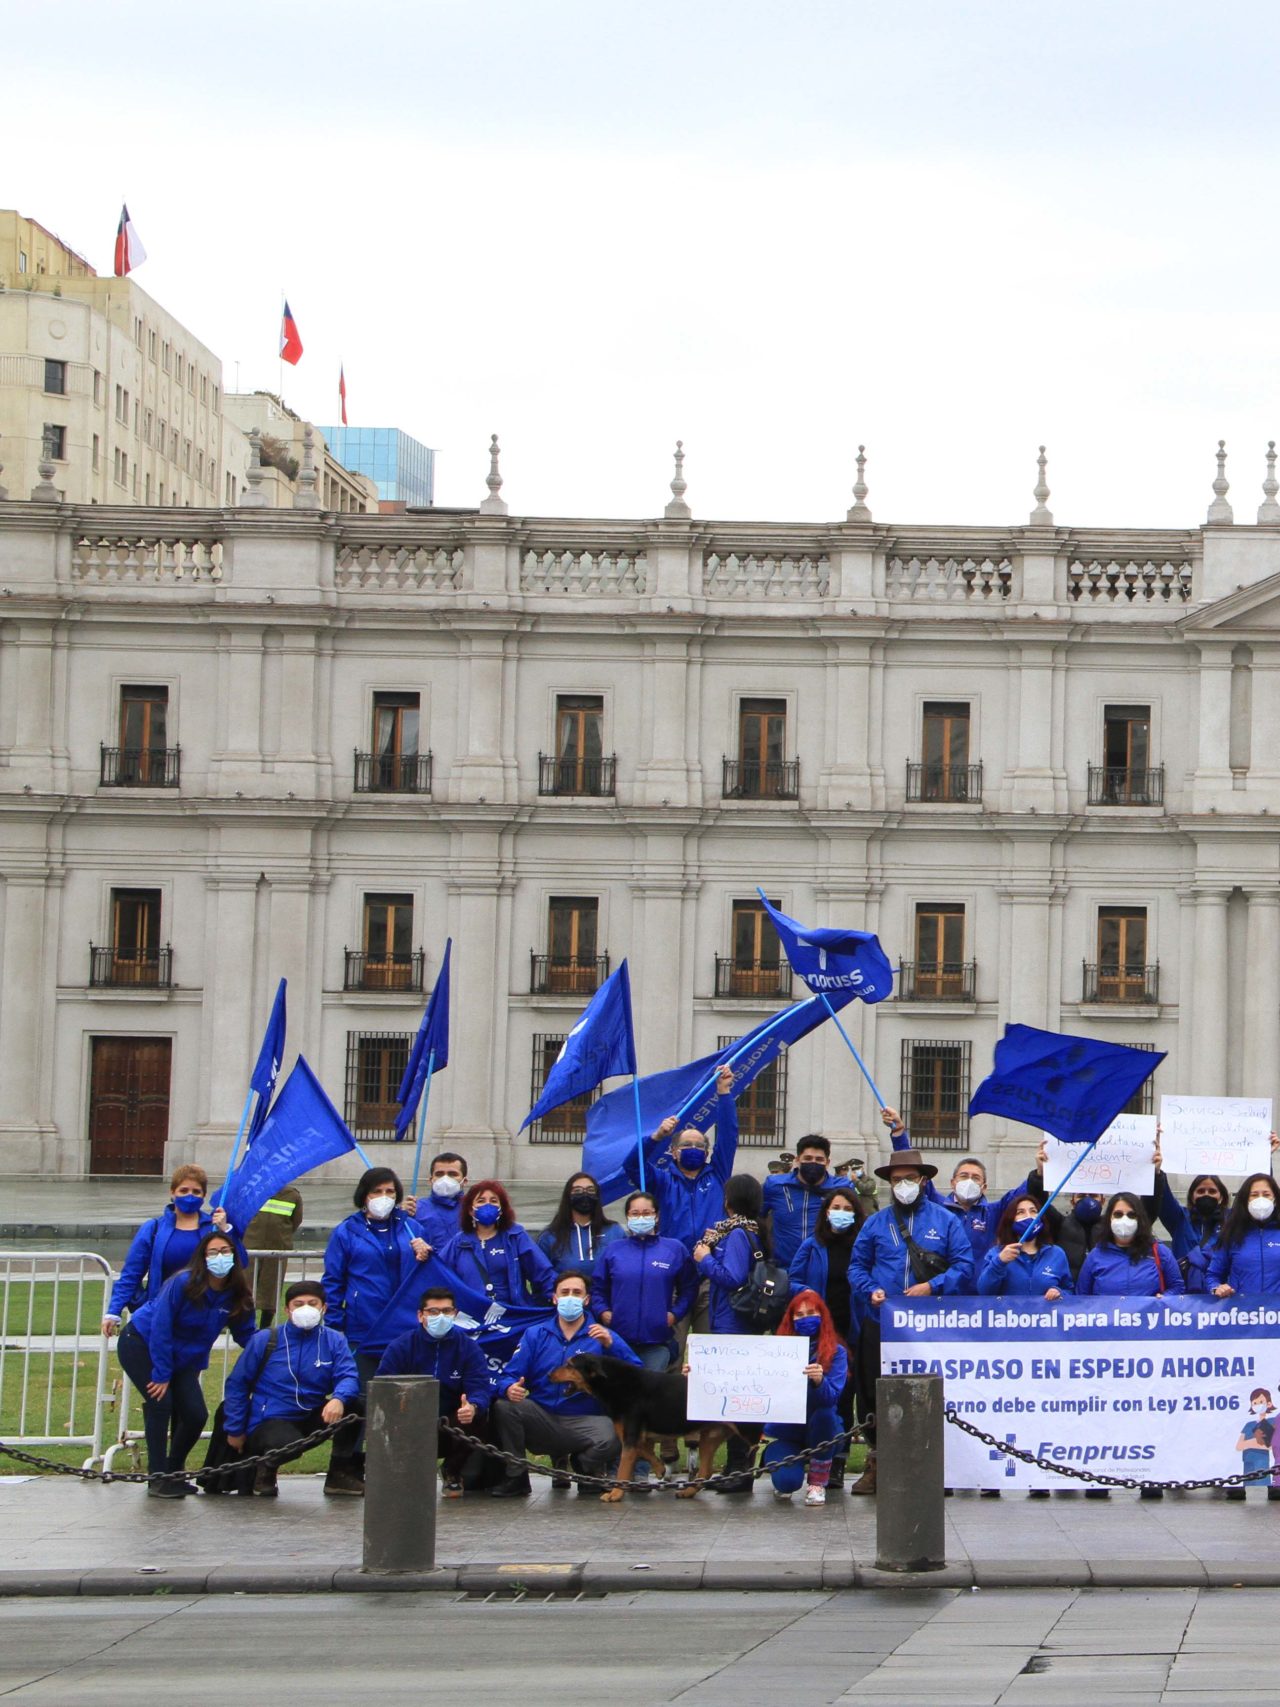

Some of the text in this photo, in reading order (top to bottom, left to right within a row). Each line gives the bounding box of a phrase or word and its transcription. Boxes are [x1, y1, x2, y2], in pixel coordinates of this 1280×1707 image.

[1230, 1102, 1268, 1119] Salud
[1111, 1120, 1136, 1130] alud
[1078, 1164, 1112, 1182] 348
[893, 1309, 982, 1332] Dignidad
[988, 1306, 1057, 1328] laboral
[1063, 1311, 1108, 1331] para
[1114, 1309, 1141, 1327] las
[1147, 1311, 1159, 1330] y
[1165, 1308, 1192, 1326] los
[756, 1342, 800, 1360] Salud
[1031, 1358, 1061, 1380] EN
[1069, 1357, 1154, 1380] ESPEJO
[1161, 1356, 1255, 1378] AHORA!
[703, 1381, 766, 1396] Oriente
[992, 1398, 1036, 1413] debe
[1041, 1396, 1107, 1416] cumplir
[1113, 1399, 1143, 1413] con
[1149, 1396, 1177, 1415] Ley
[1183, 1395, 1240, 1411] 21.106
[1037, 1442, 1156, 1465] Fenpruss
